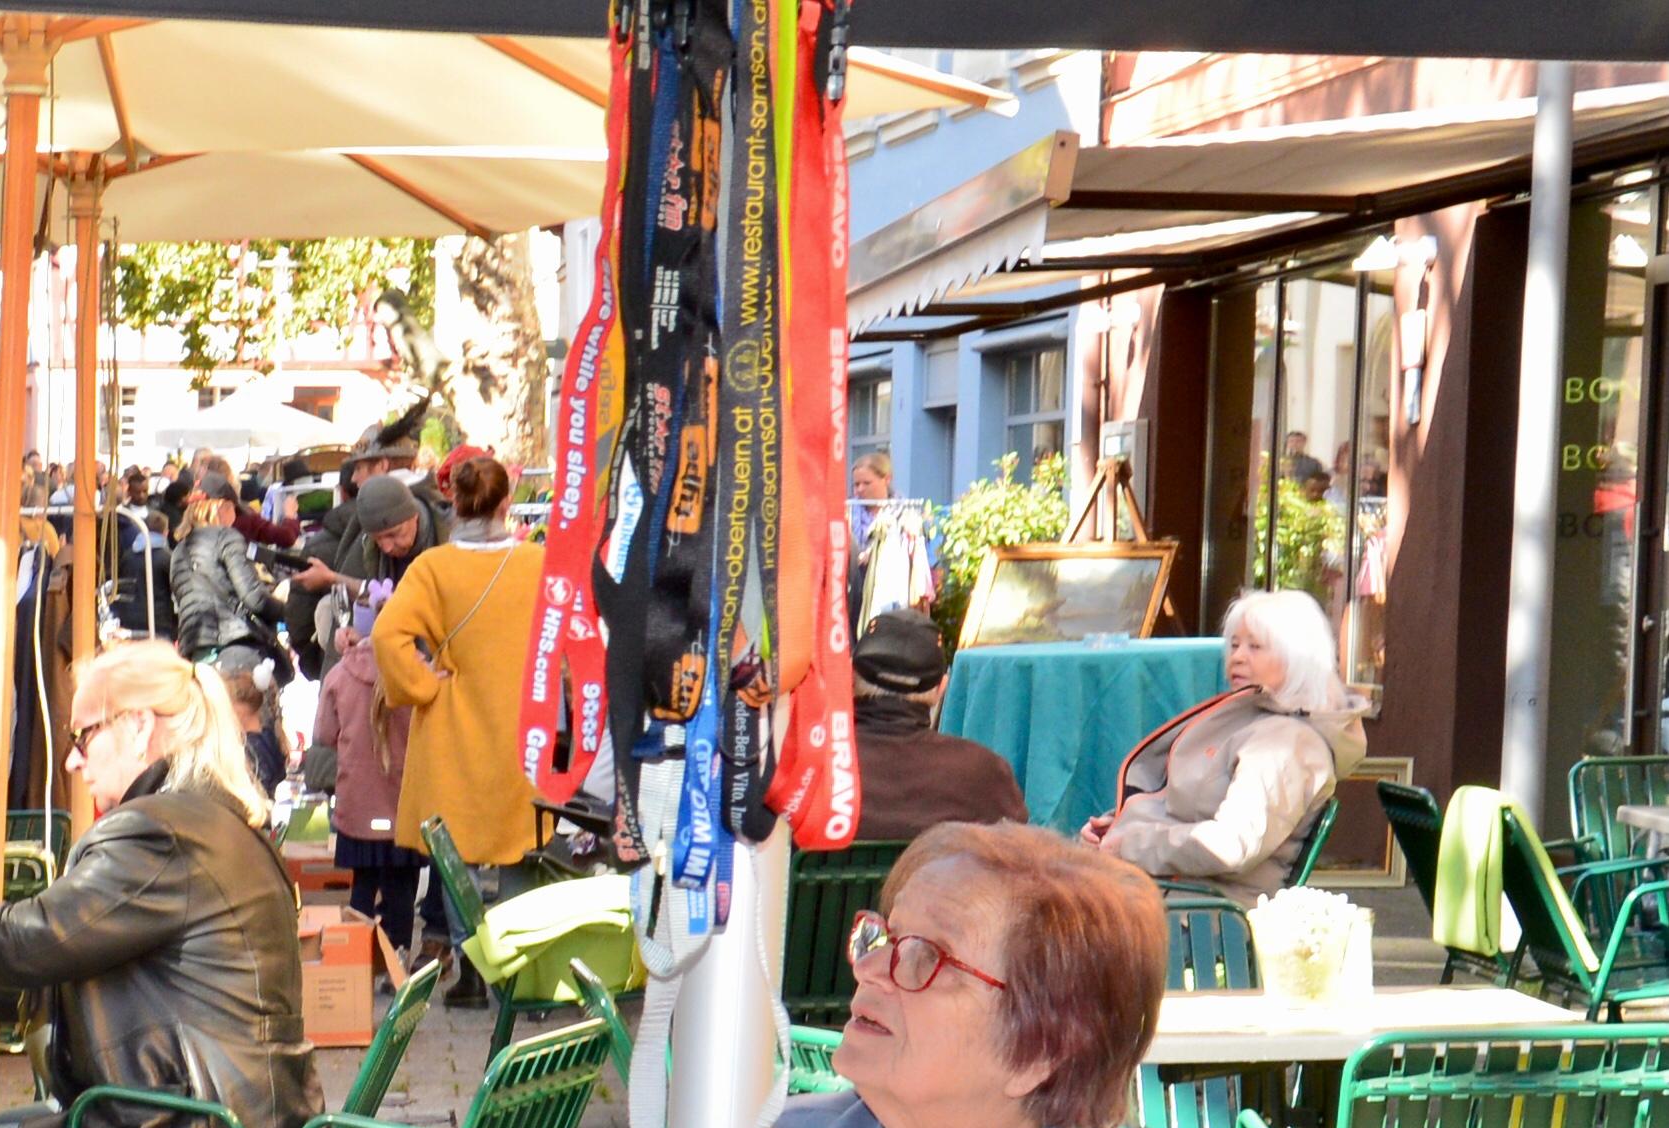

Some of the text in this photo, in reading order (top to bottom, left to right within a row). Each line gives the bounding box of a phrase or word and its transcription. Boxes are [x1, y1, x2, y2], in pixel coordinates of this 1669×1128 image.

[574, 325, 605, 393] while
[828, 327, 846, 461] BRAVO
[569, 397, 587, 446] you
[559, 449, 587, 530] sleep.
[828, 521, 849, 654] BRAVO
[532, 607, 563, 703] HRS.com
[826, 711, 852, 842] BRAVO
